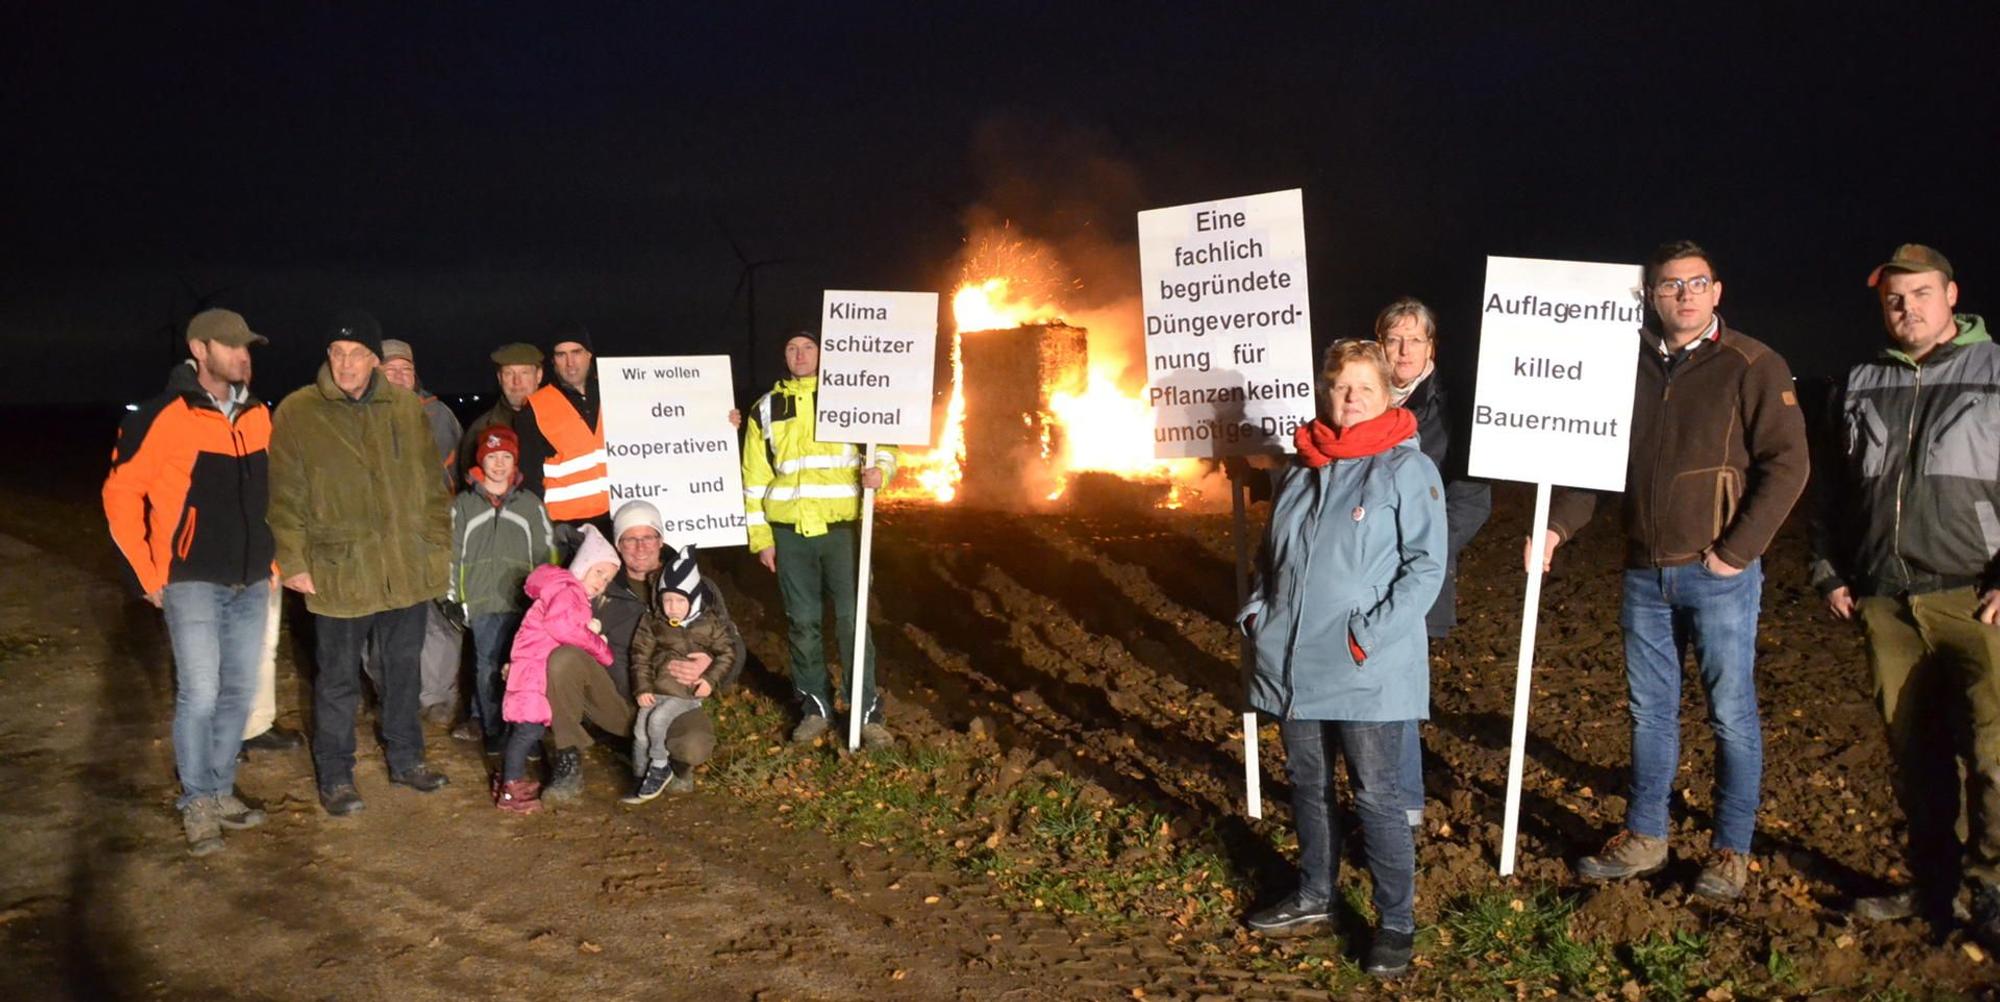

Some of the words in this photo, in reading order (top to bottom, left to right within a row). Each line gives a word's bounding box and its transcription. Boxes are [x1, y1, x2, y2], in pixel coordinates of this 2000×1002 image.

[1196, 210, 1246, 232] Eine
[1175, 238, 1263, 267] fachlich
[1160, 270, 1291, 303] begründete
[829, 302, 887, 320] Klima
[1485, 293, 1642, 324] Auflagenflut
[1147, 304, 1303, 337] Düngeverord-
[824, 335, 914, 354] schützer
[1155, 351, 1211, 372] nung
[1233, 344, 1266, 365] für
[1514, 356, 1583, 381] killed
[622, 367, 647, 381] Wir
[654, 366, 700, 379] wollen
[822, 369, 890, 388] kaufen
[651, 402, 685, 418] den
[818, 407, 901, 428] regional
[1154, 418, 1250, 444] unnötige
[1475, 405, 1618, 438] Bauernmut
[606, 438, 728, 459] kooperativen
[609, 483, 668, 500] Natur-
[689, 477, 724, 494] und
[664, 513, 745, 532] erschutz
